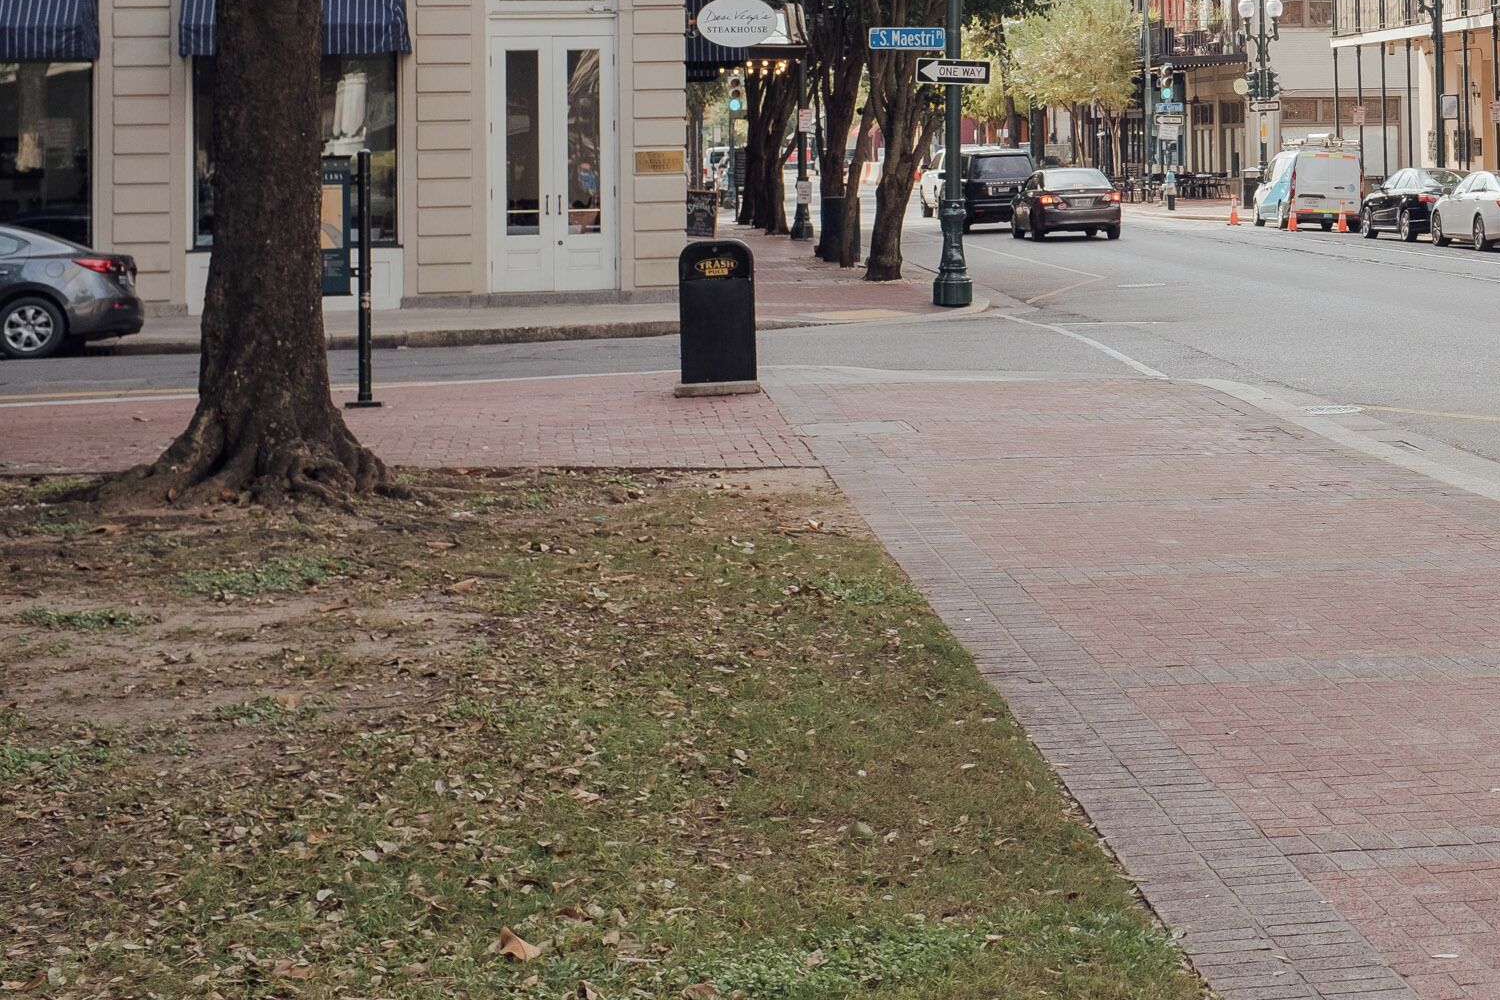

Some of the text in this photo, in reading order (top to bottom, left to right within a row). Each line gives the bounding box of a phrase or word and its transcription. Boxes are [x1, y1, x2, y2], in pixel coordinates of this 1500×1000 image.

[707, 26, 768, 34] STEAKHOUSE
[880, 29, 943, 46] S. Maestri Pl
[938, 66, 983, 78] ONE WAY
[700, 260, 735, 269] TRASH
